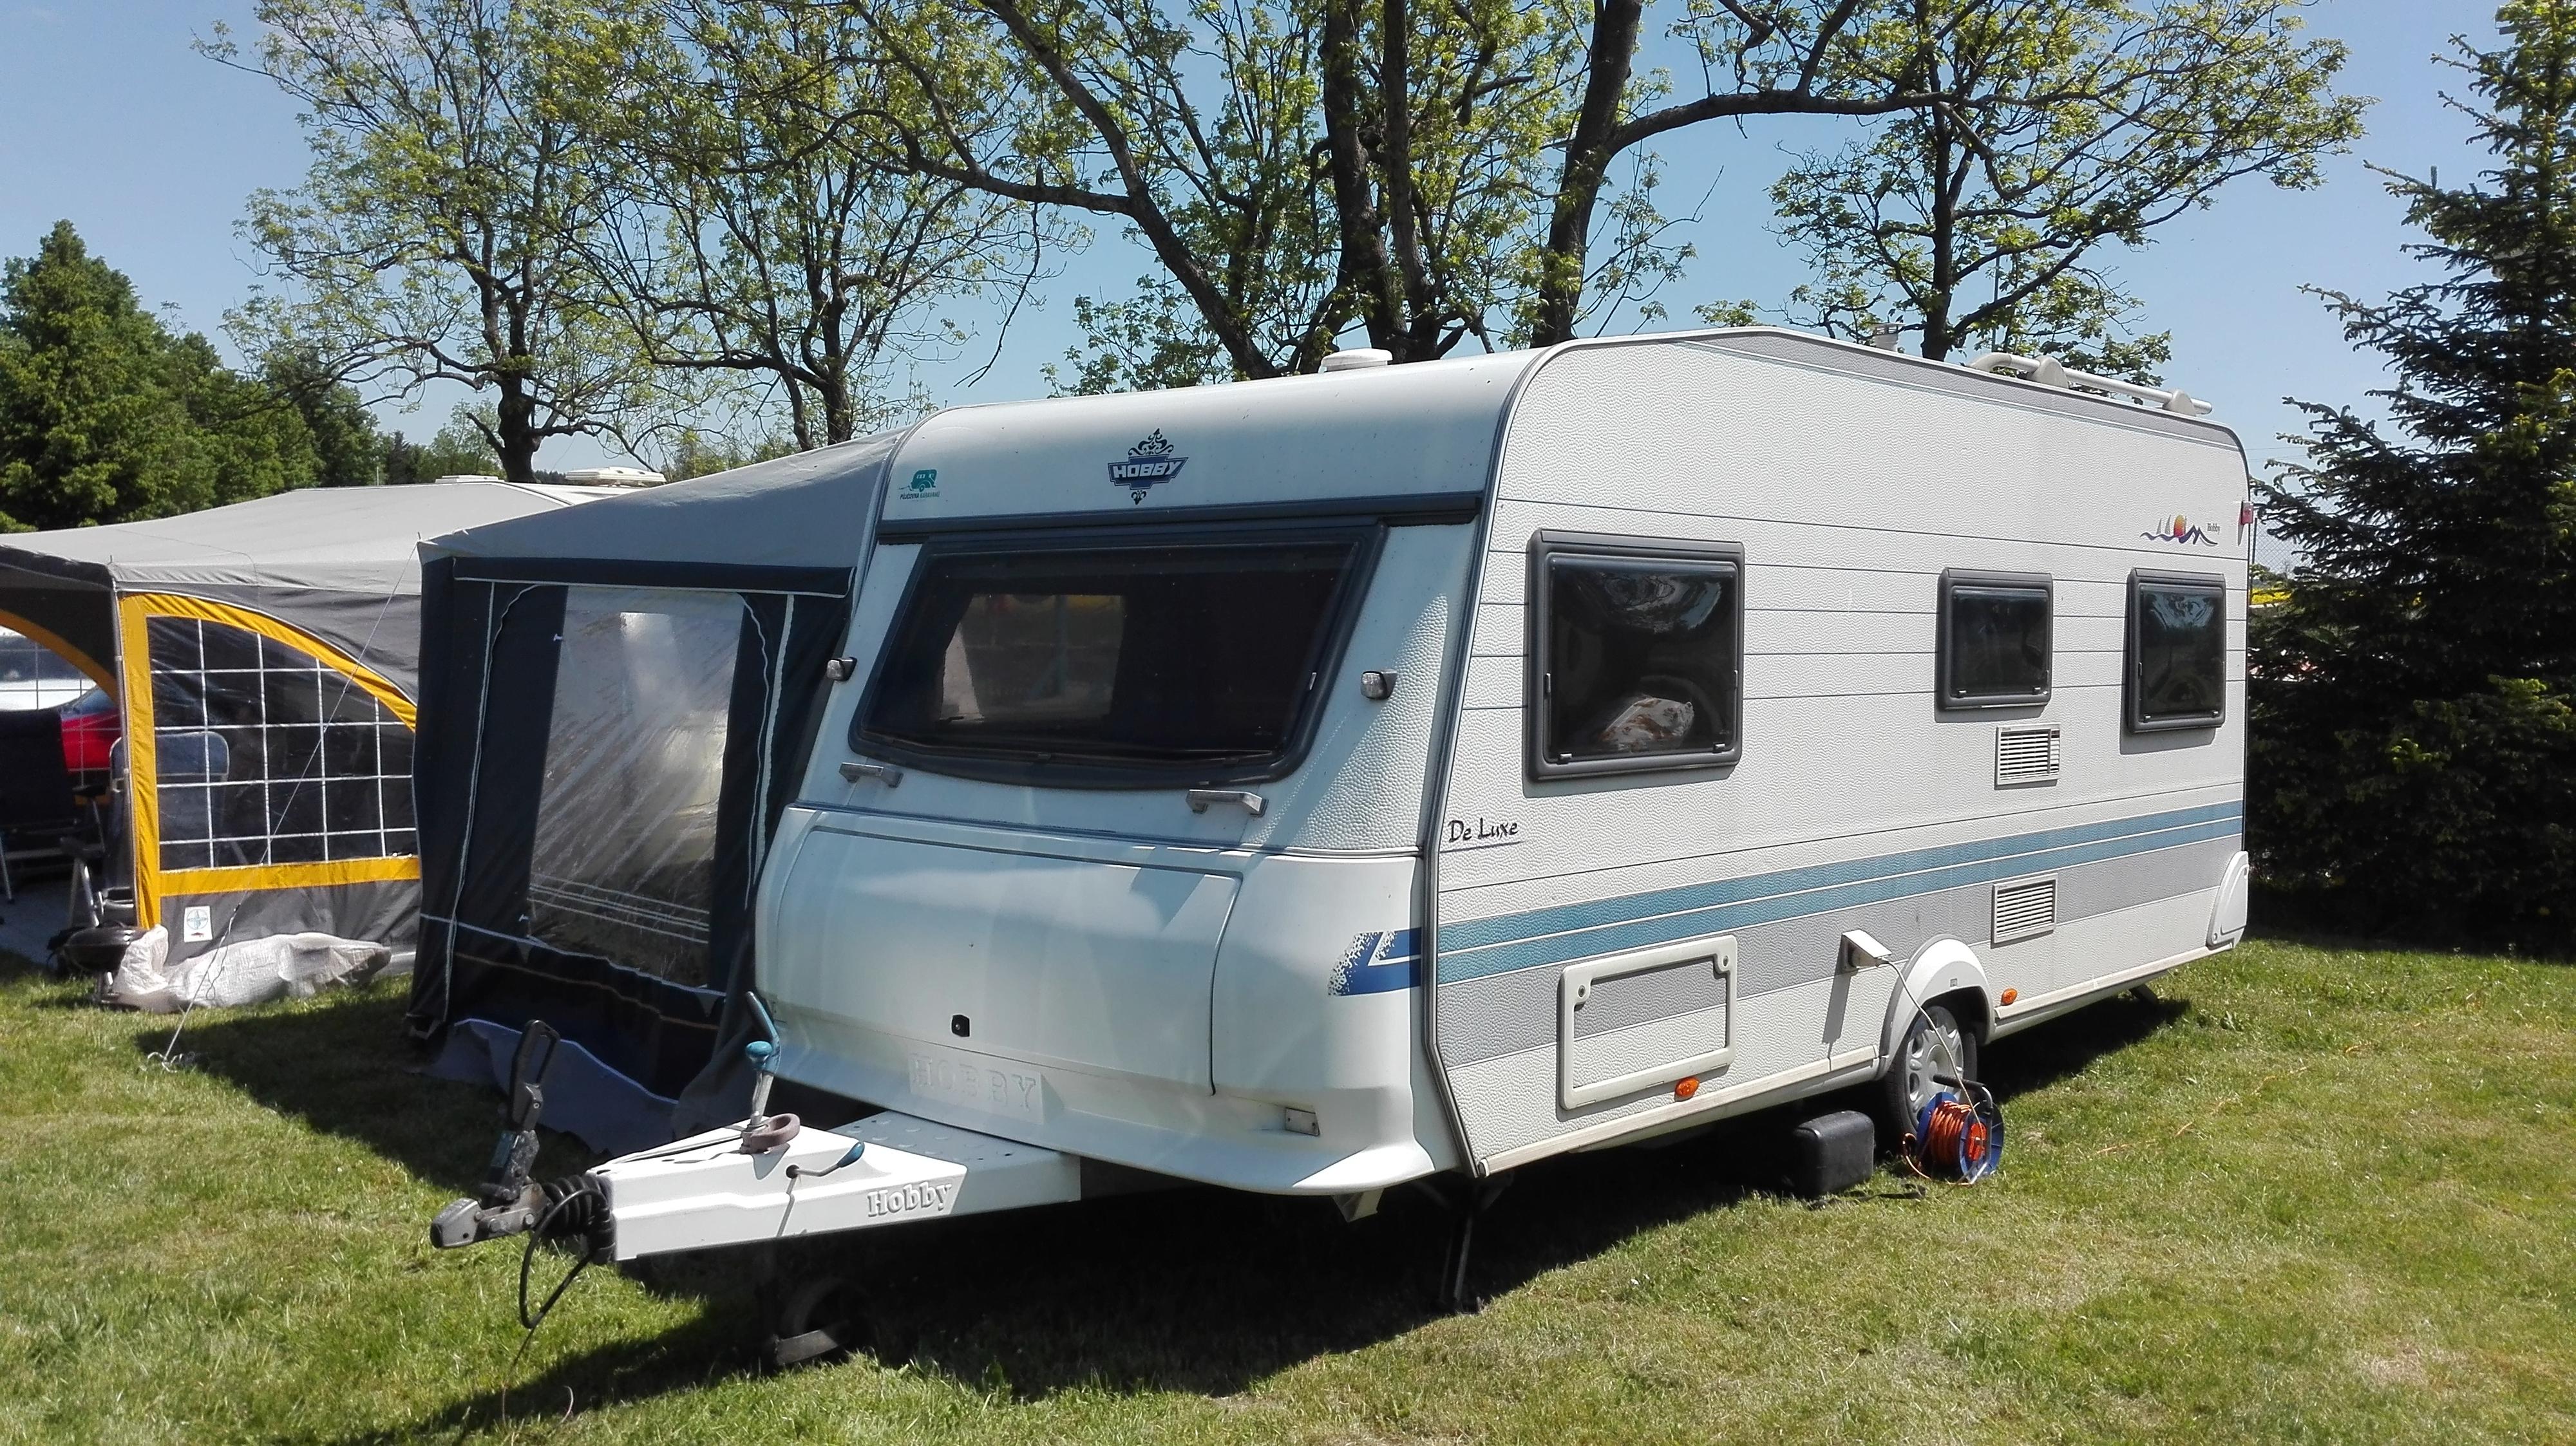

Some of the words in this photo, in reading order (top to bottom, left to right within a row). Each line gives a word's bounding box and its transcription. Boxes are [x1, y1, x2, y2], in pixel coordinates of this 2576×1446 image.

[1112, 460, 1183, 478] HOBBY
[2207, 523, 2221, 534] Hobby
[1448, 819, 1472, 843] De
[1478, 817, 1519, 840] Luxe
[910, 1052, 1036, 1113] HOBBY
[867, 1181, 952, 1217] Hobby
